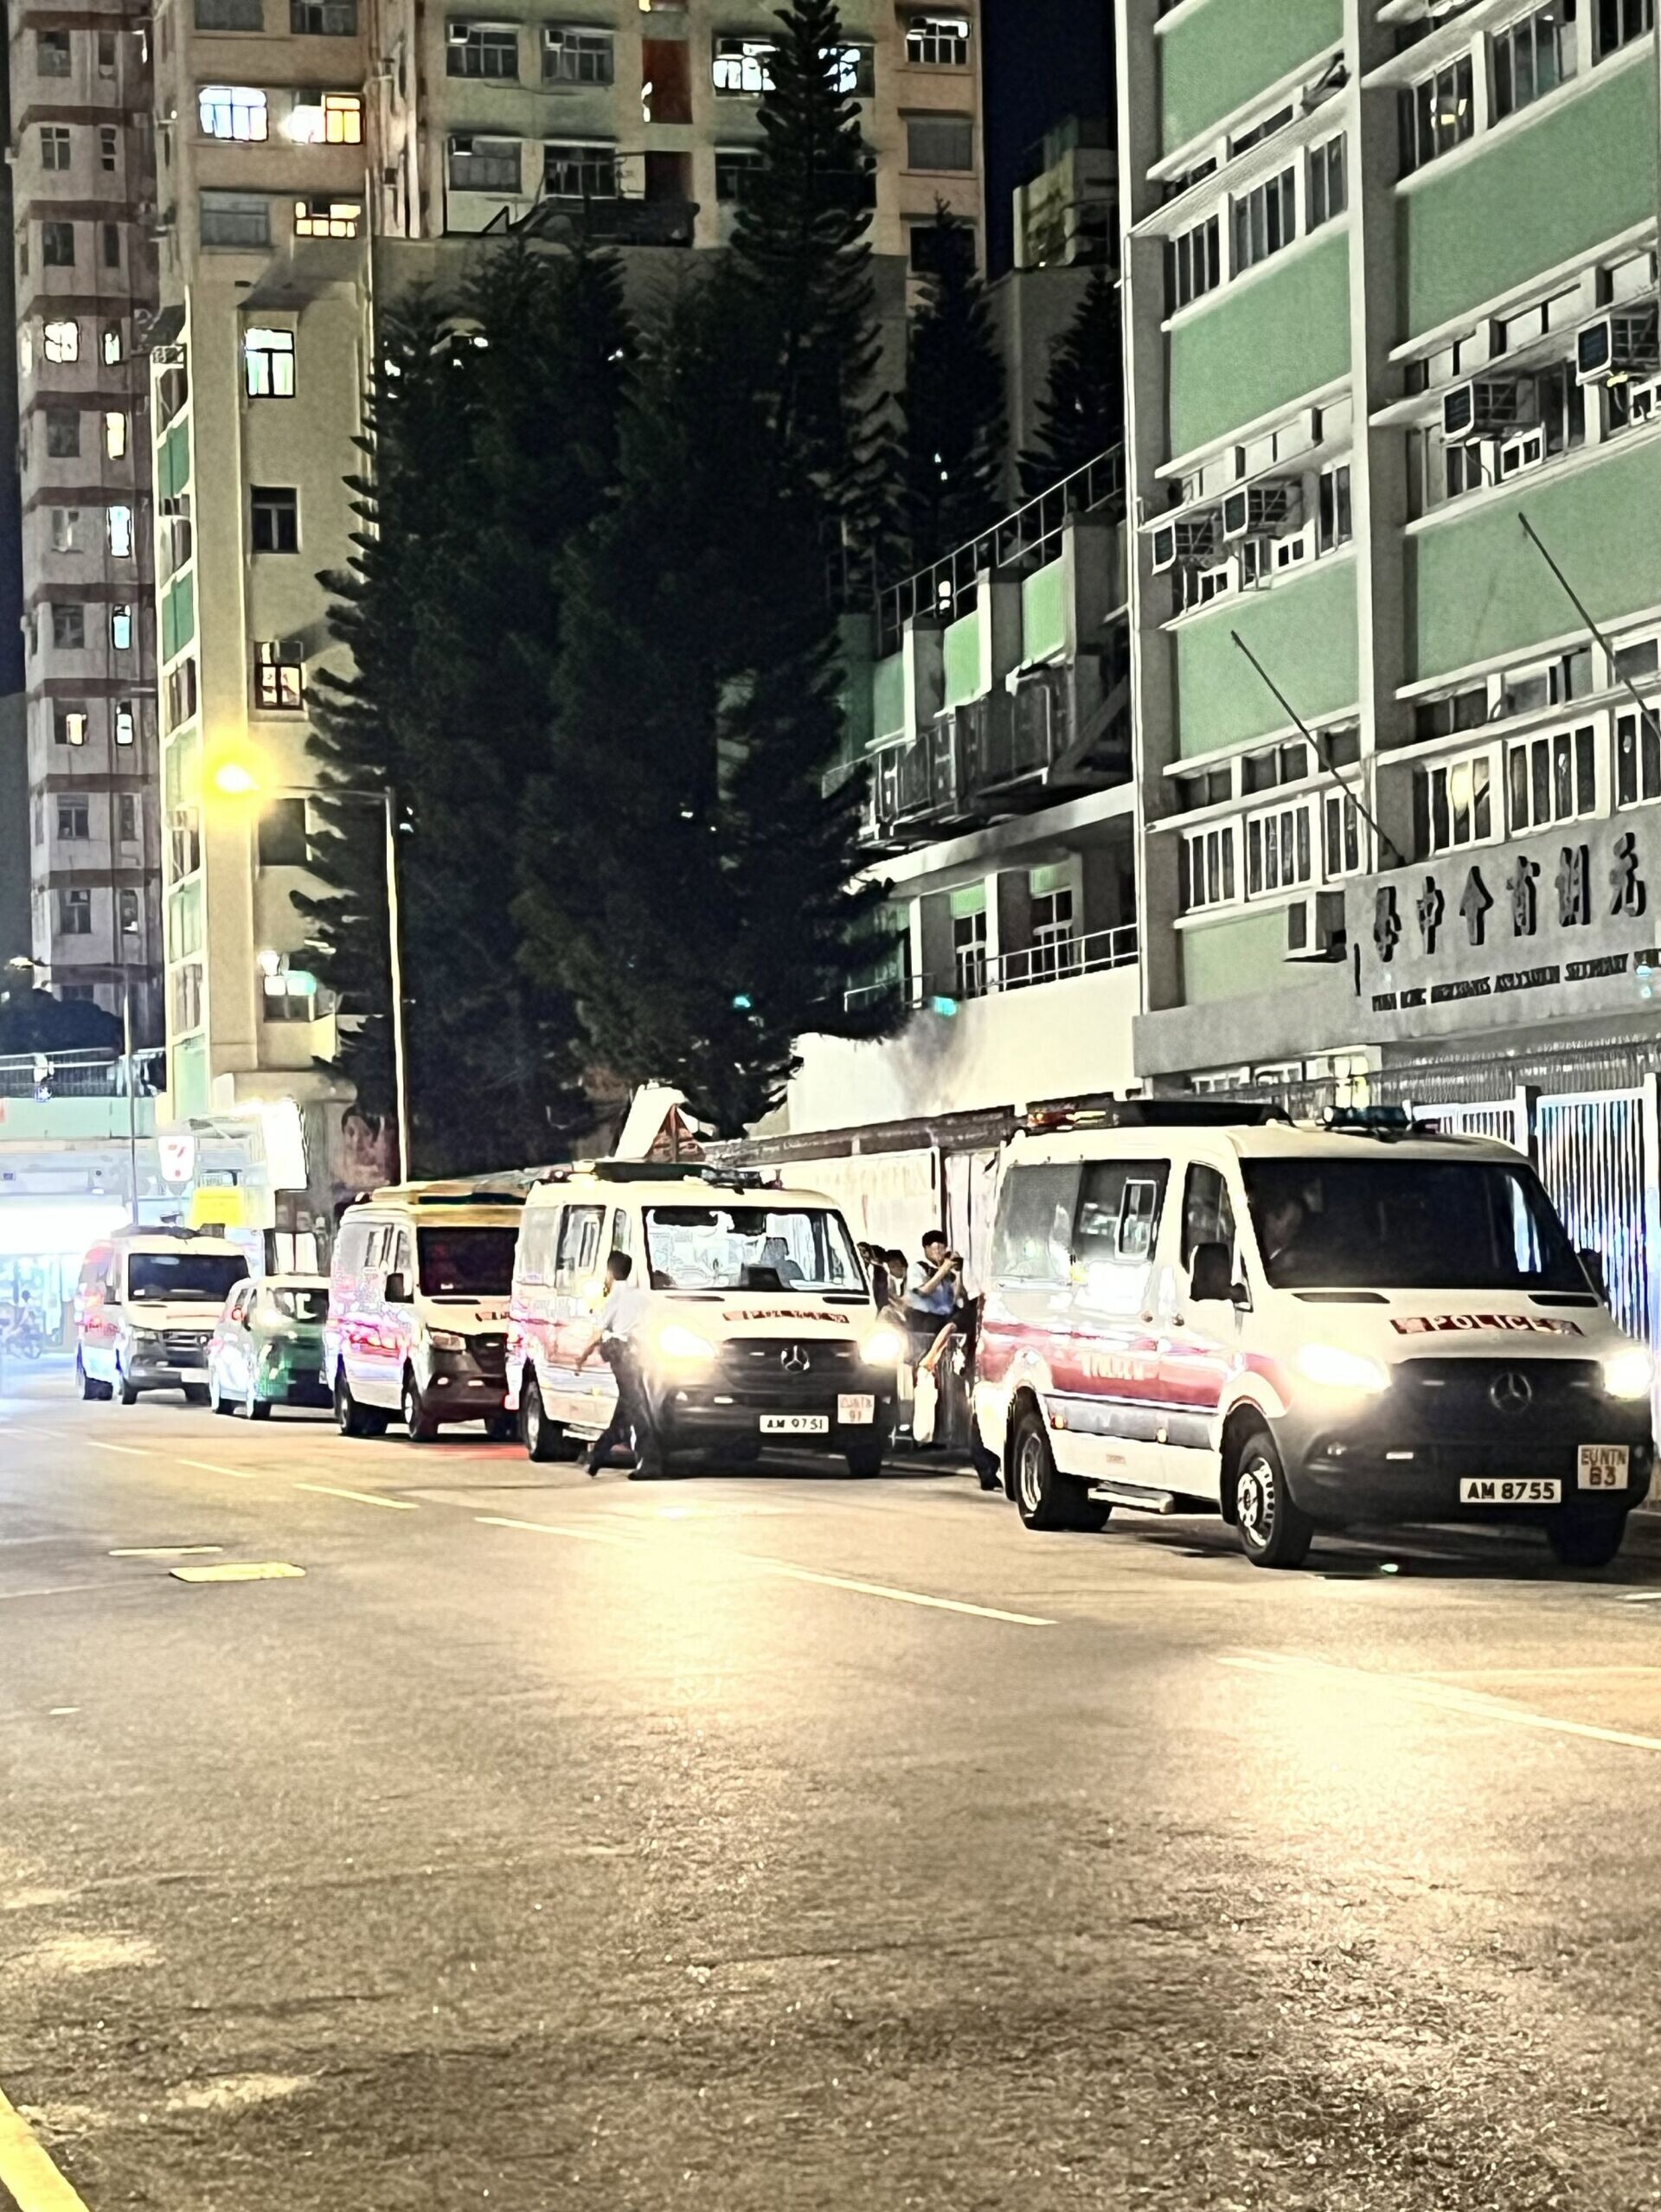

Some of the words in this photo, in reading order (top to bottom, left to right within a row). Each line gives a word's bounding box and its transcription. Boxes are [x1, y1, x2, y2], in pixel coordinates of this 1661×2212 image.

[1427, 1314, 1551, 1332] POLICE
[1467, 1482, 1495, 1499] AM
[1501, 1482, 1555, 1500] 8755
